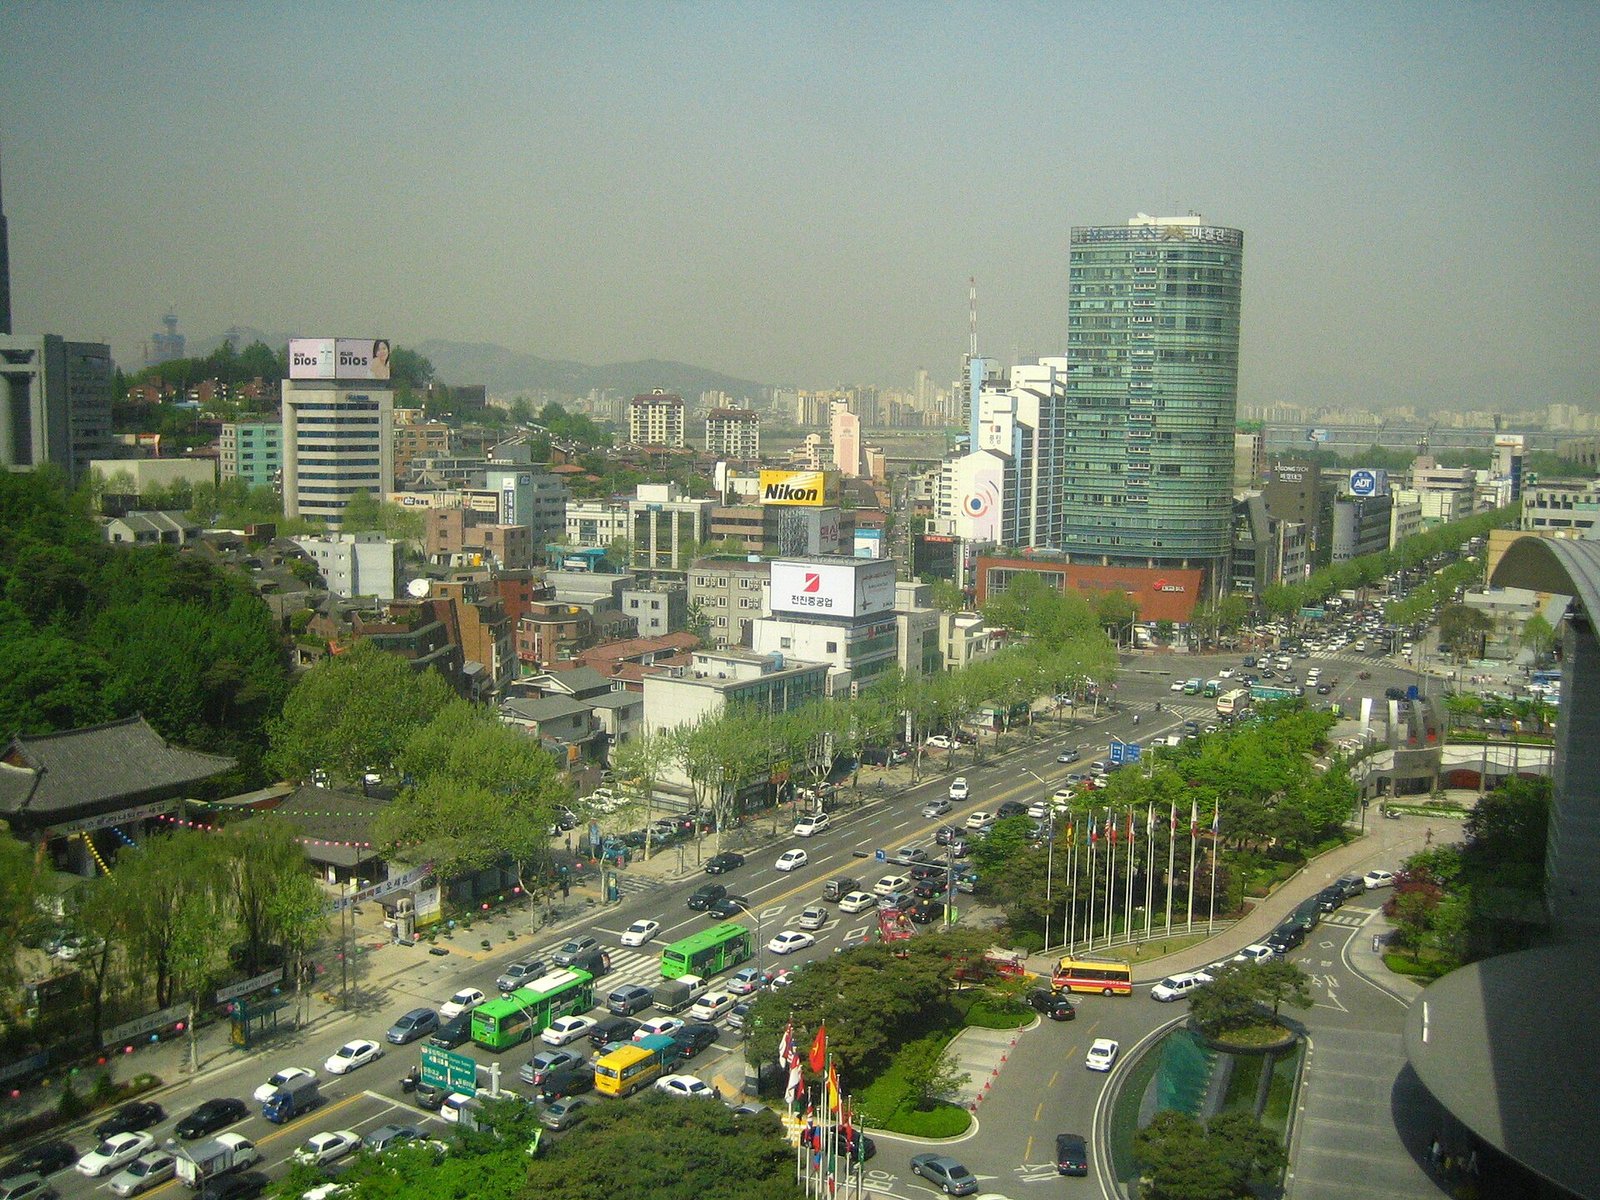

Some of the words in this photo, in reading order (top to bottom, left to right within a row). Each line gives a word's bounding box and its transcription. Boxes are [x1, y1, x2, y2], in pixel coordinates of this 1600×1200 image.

[294, 357, 317, 366] DIOS
[340, 356, 368, 366] DIOS
[1354, 479, 1371, 488] ADT
[765, 483, 818, 501] Nikon
[791, 594, 833, 608] 전진중공업
